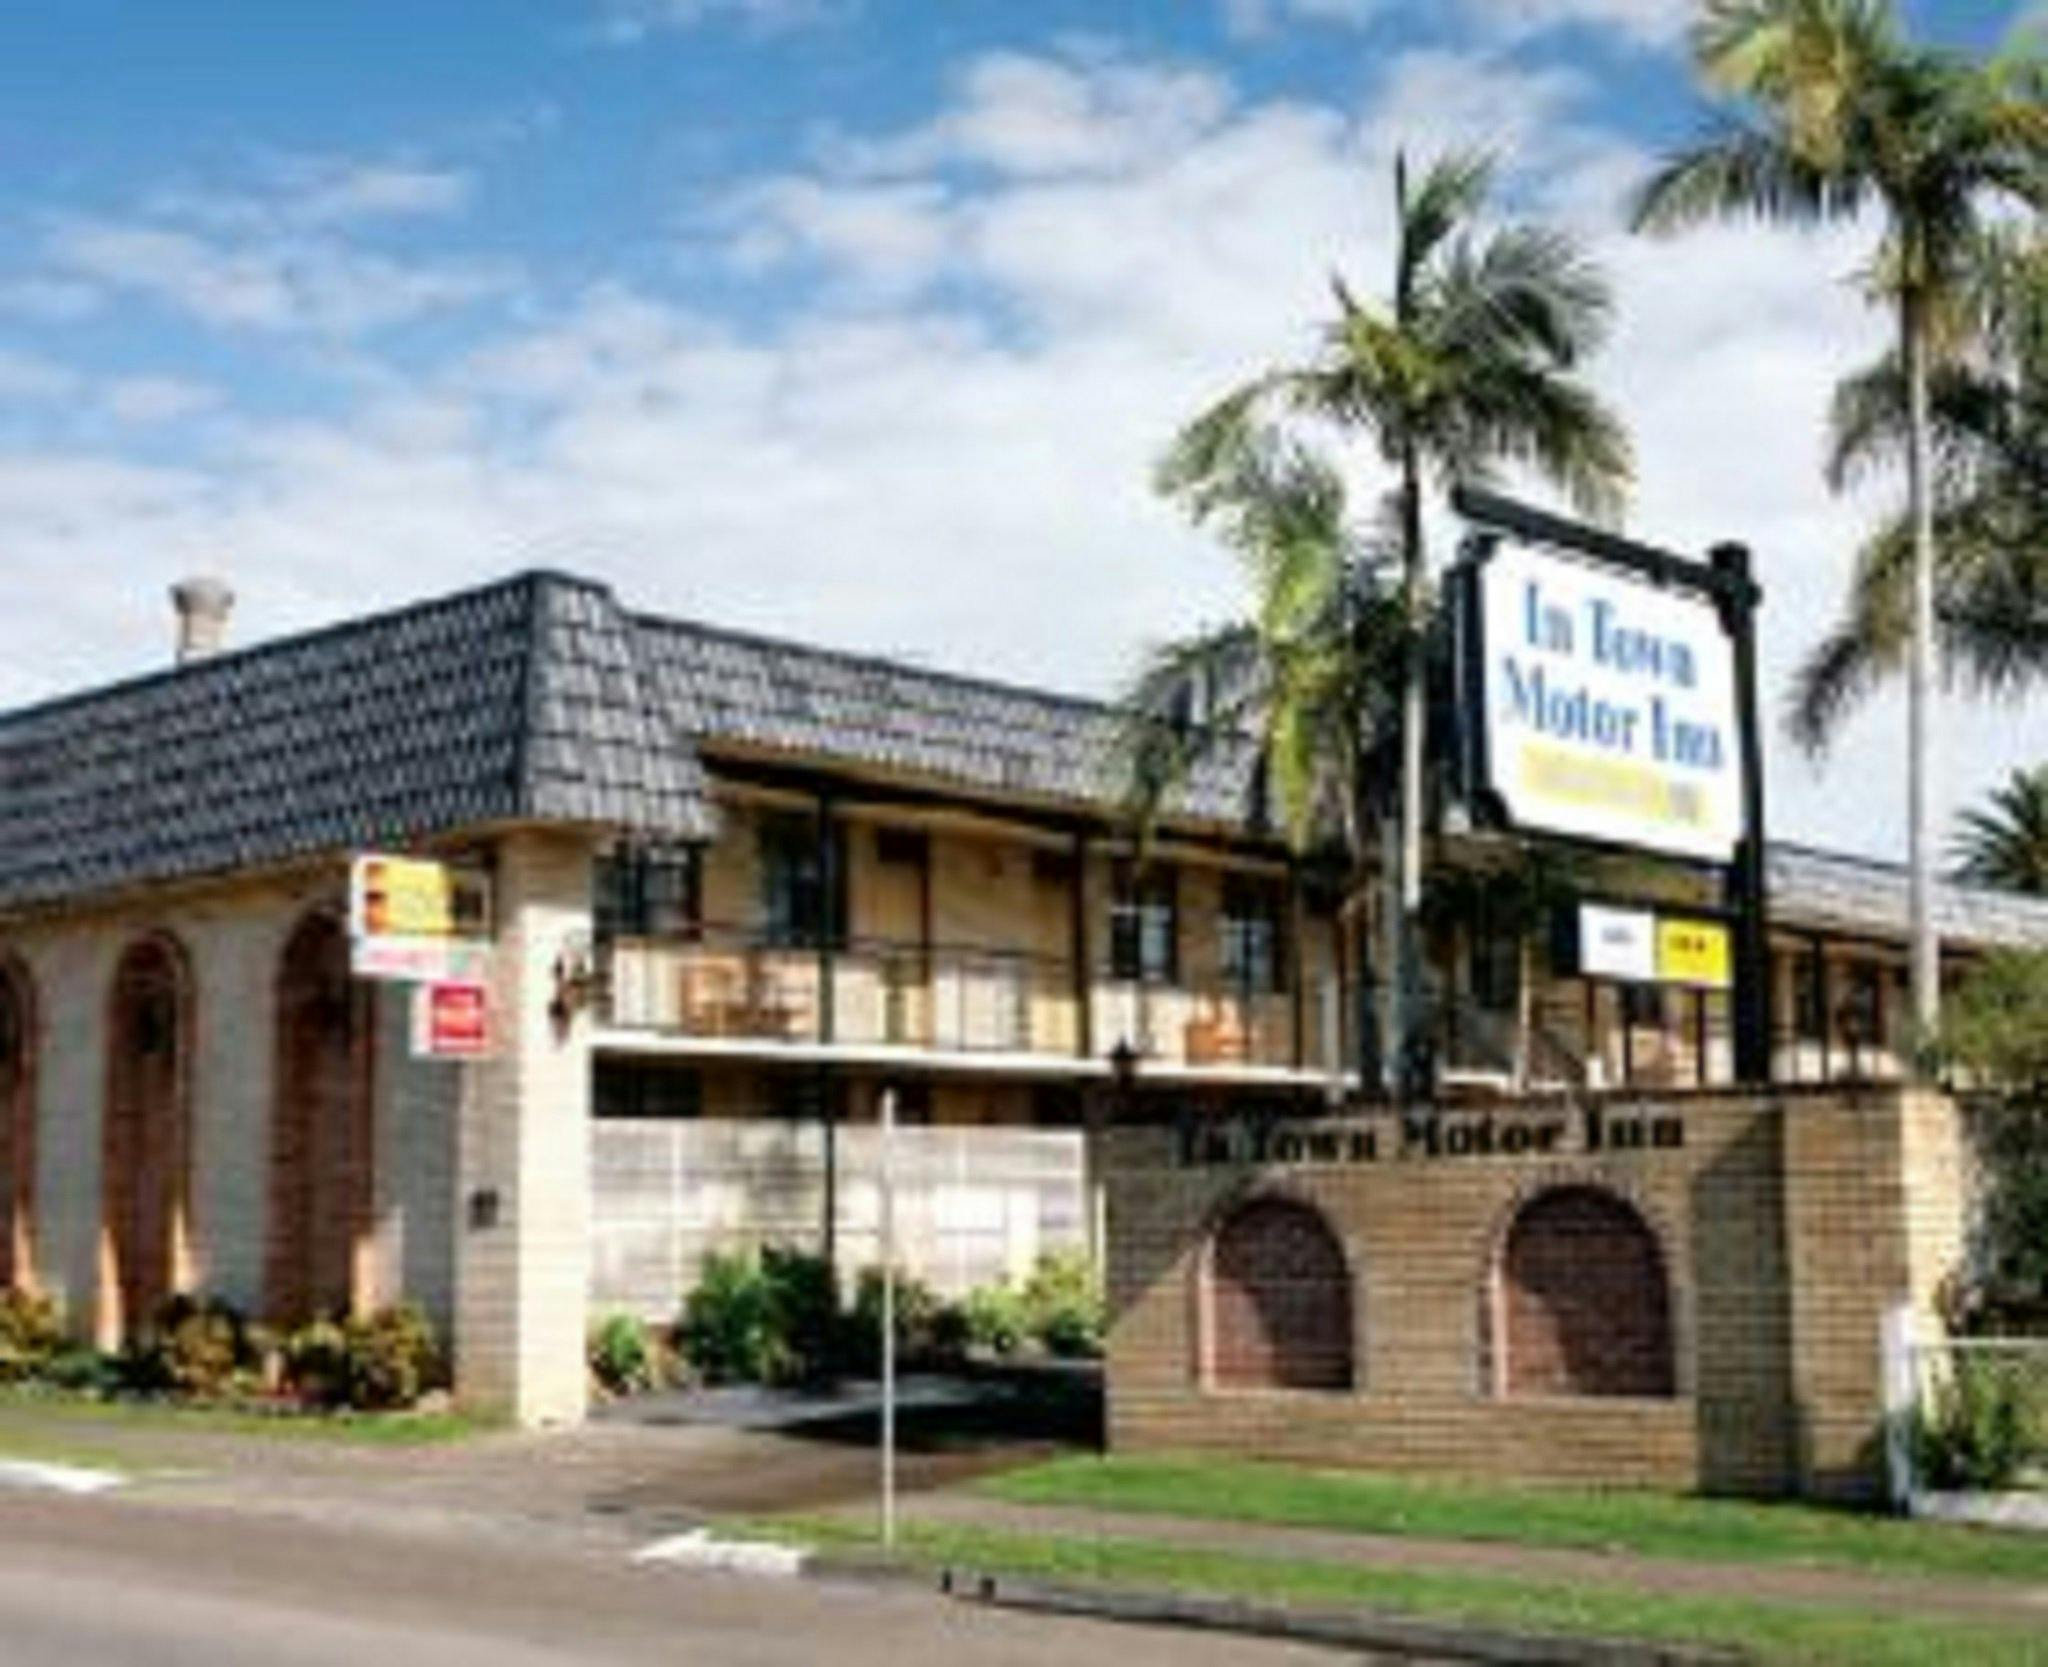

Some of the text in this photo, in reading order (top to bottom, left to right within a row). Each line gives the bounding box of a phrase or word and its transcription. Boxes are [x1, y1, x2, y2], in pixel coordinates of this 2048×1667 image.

[1525, 581, 1696, 688] In Town
[1502, 657, 1724, 768] Motor Inn
[1240, 1107, 1377, 1163] Town
[1402, 1107, 1565, 1156] Motor
[1586, 1106, 1684, 1152] Inn
